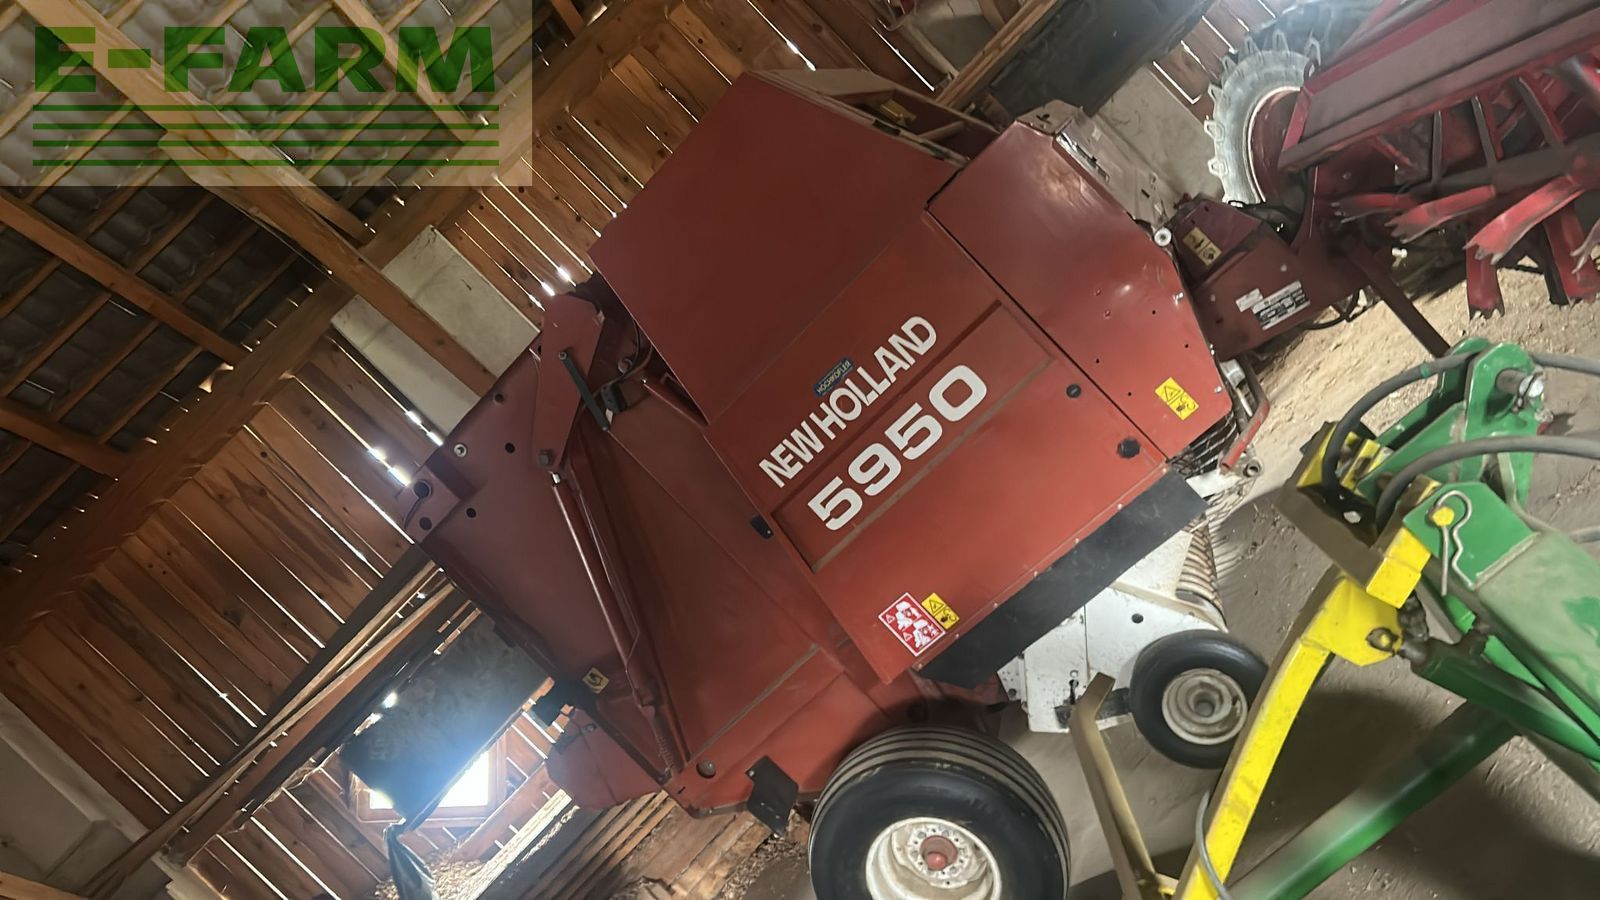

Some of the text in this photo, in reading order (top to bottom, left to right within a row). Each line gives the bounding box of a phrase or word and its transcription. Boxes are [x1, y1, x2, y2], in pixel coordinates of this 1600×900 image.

[759, 316, 937, 488] NEW HOLLAND
[808, 365, 987, 531] 5950
